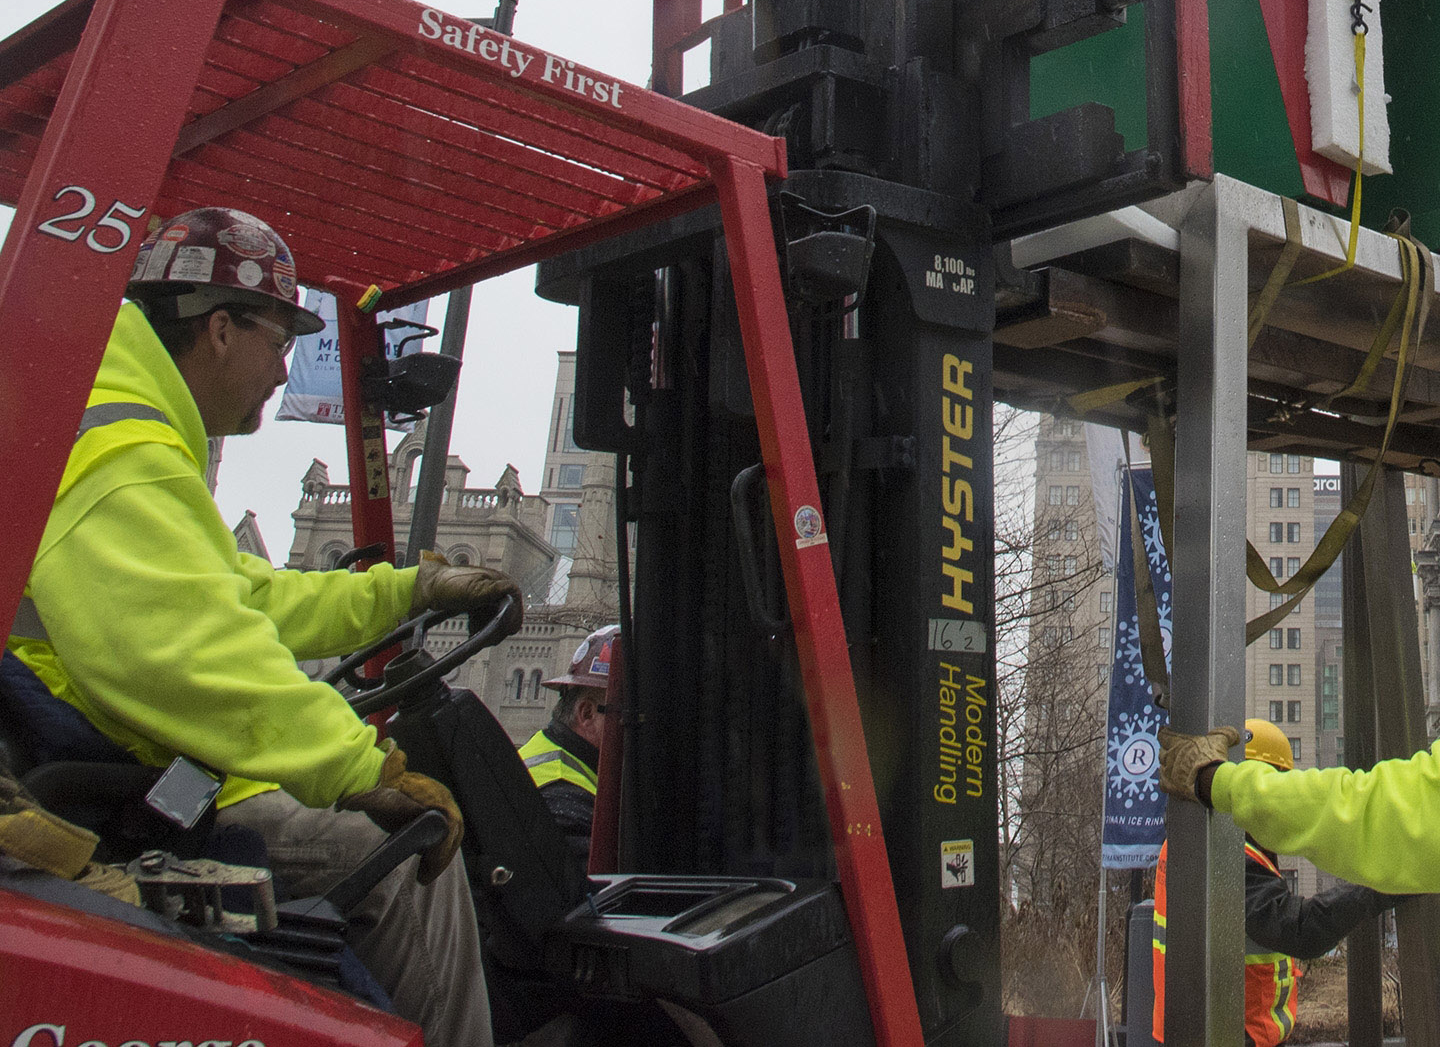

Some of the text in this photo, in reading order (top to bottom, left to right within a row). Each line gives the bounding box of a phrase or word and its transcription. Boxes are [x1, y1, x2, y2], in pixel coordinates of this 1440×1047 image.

[418, 8, 624, 108] Safety First
[38, 185, 147, 253] 25
[934, 254, 964, 275] 8,100
[926, 270, 944, 289] MA
[316, 354, 329, 362] AT
[941, 353, 974, 614] HYSTER
[1313, 479, 1340, 491] ara
[934, 661, 961, 805] Handling
[966, 674, 987, 798] Modern
[1131, 748, 1146, 766] R
[1128, 816, 1143, 826] ICE
